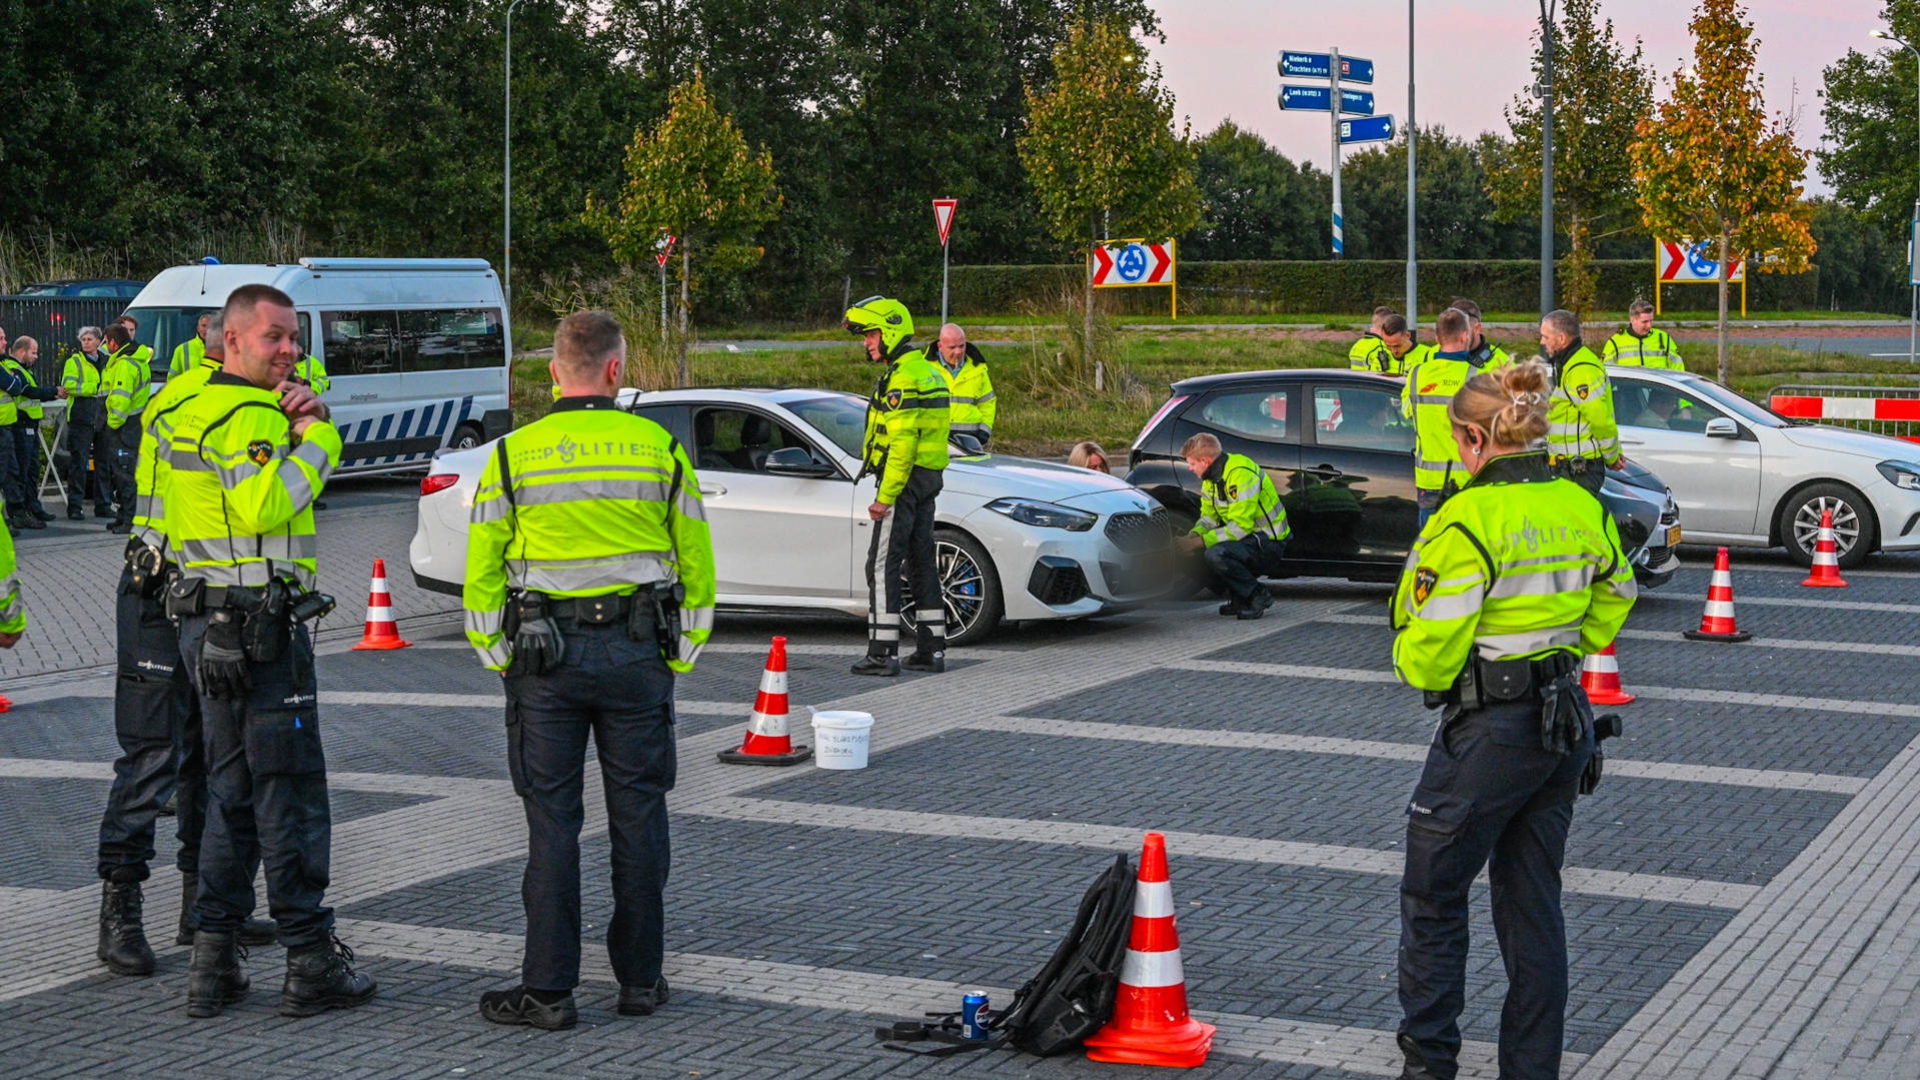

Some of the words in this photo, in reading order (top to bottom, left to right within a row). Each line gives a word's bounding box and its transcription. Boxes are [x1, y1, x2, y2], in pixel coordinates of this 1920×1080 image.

[1289, 65, 1311, 73] Drachten
[1443, 379, 1459, 387] RDW
[544, 439, 640, 463] POLITIE
